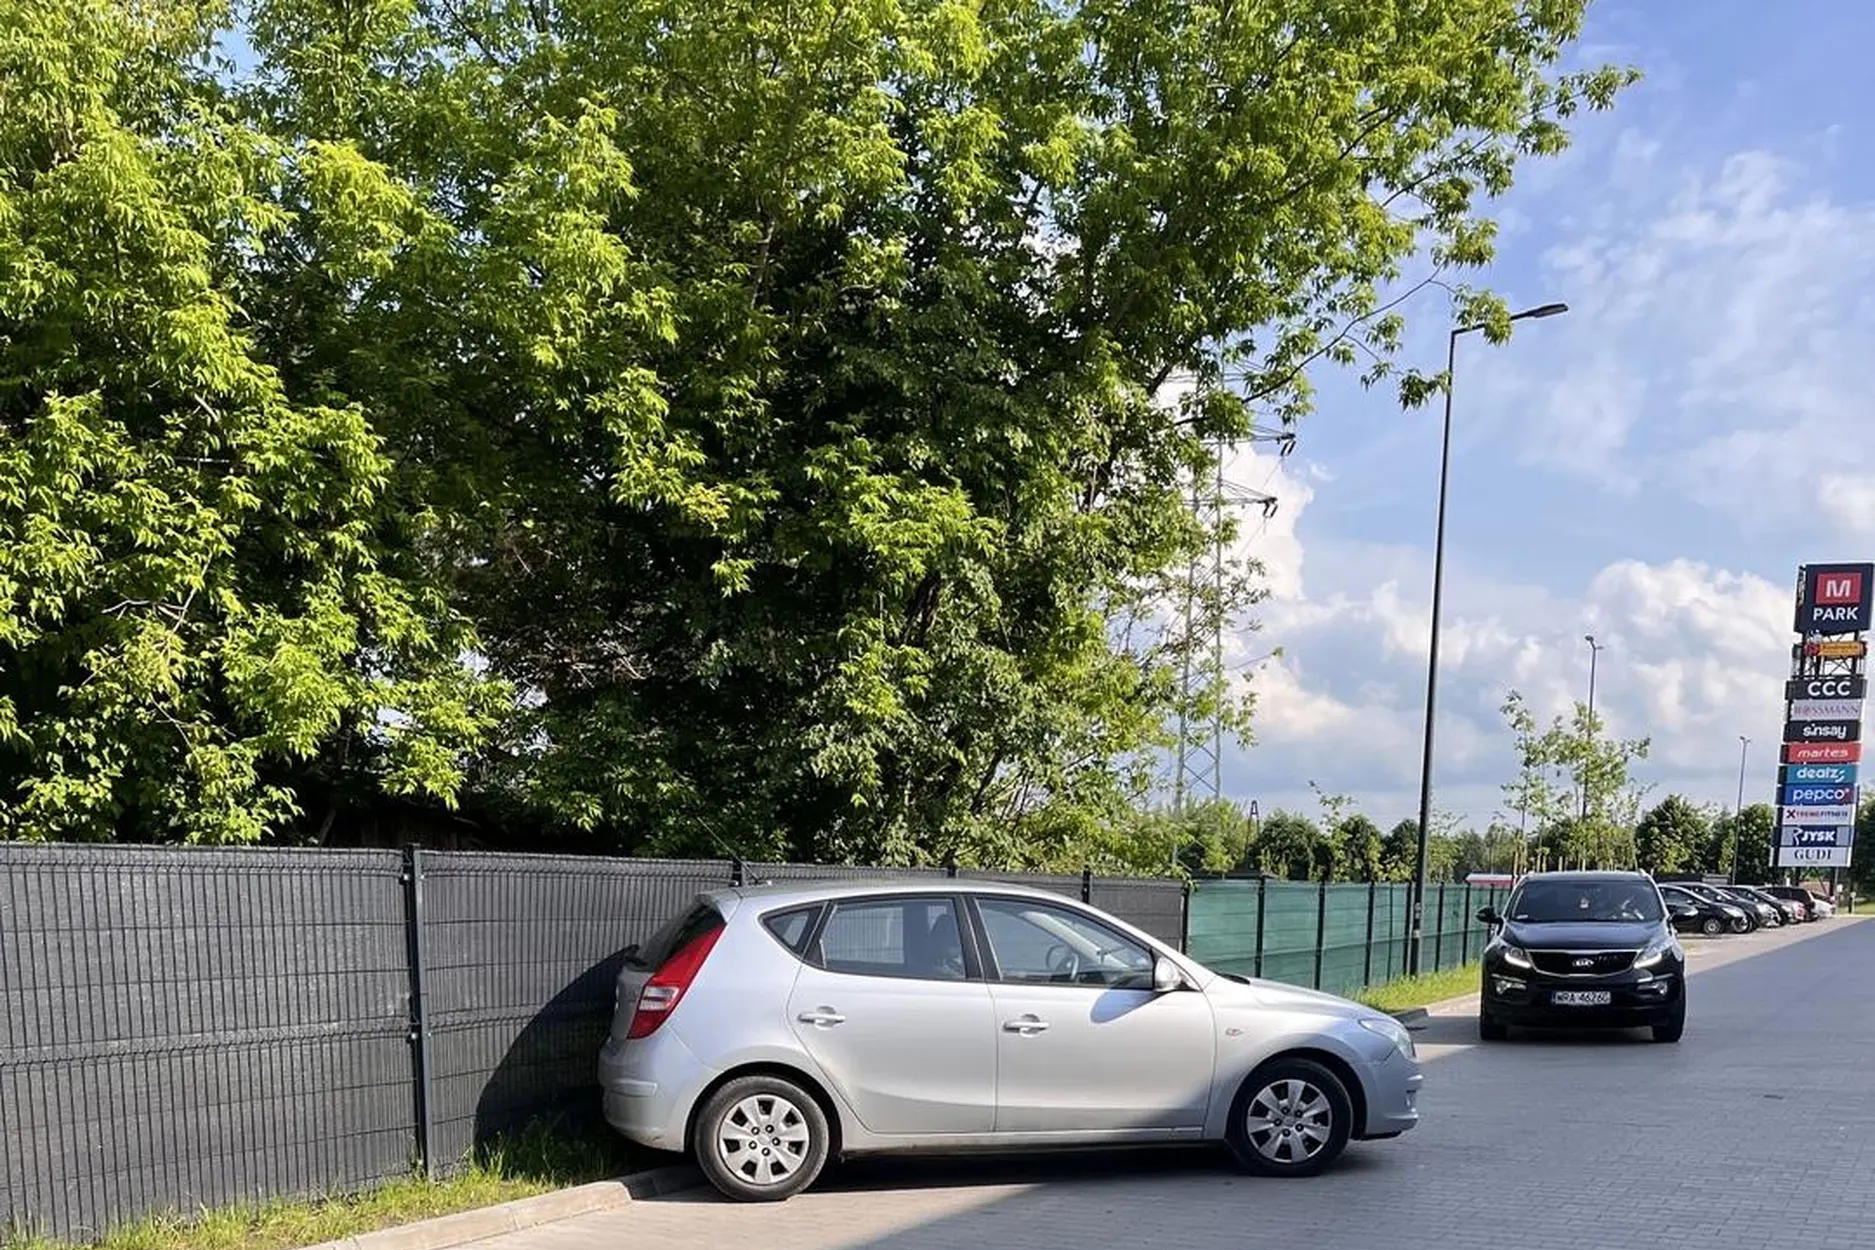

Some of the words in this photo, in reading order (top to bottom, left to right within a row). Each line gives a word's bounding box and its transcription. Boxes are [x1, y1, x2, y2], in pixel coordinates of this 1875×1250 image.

[1826, 580, 1851, 598] M
[1813, 606, 1859, 621] PARK
[1807, 680, 1852, 696] CCC
[1803, 723, 1847, 739] sinsay
[1797, 749, 1849, 758] martes
[1796, 768, 1843, 781] dealz
[1792, 788, 1845, 802] pepco
[1801, 831, 1836, 841] JYSK
[1794, 849, 1832, 860] GUDI
